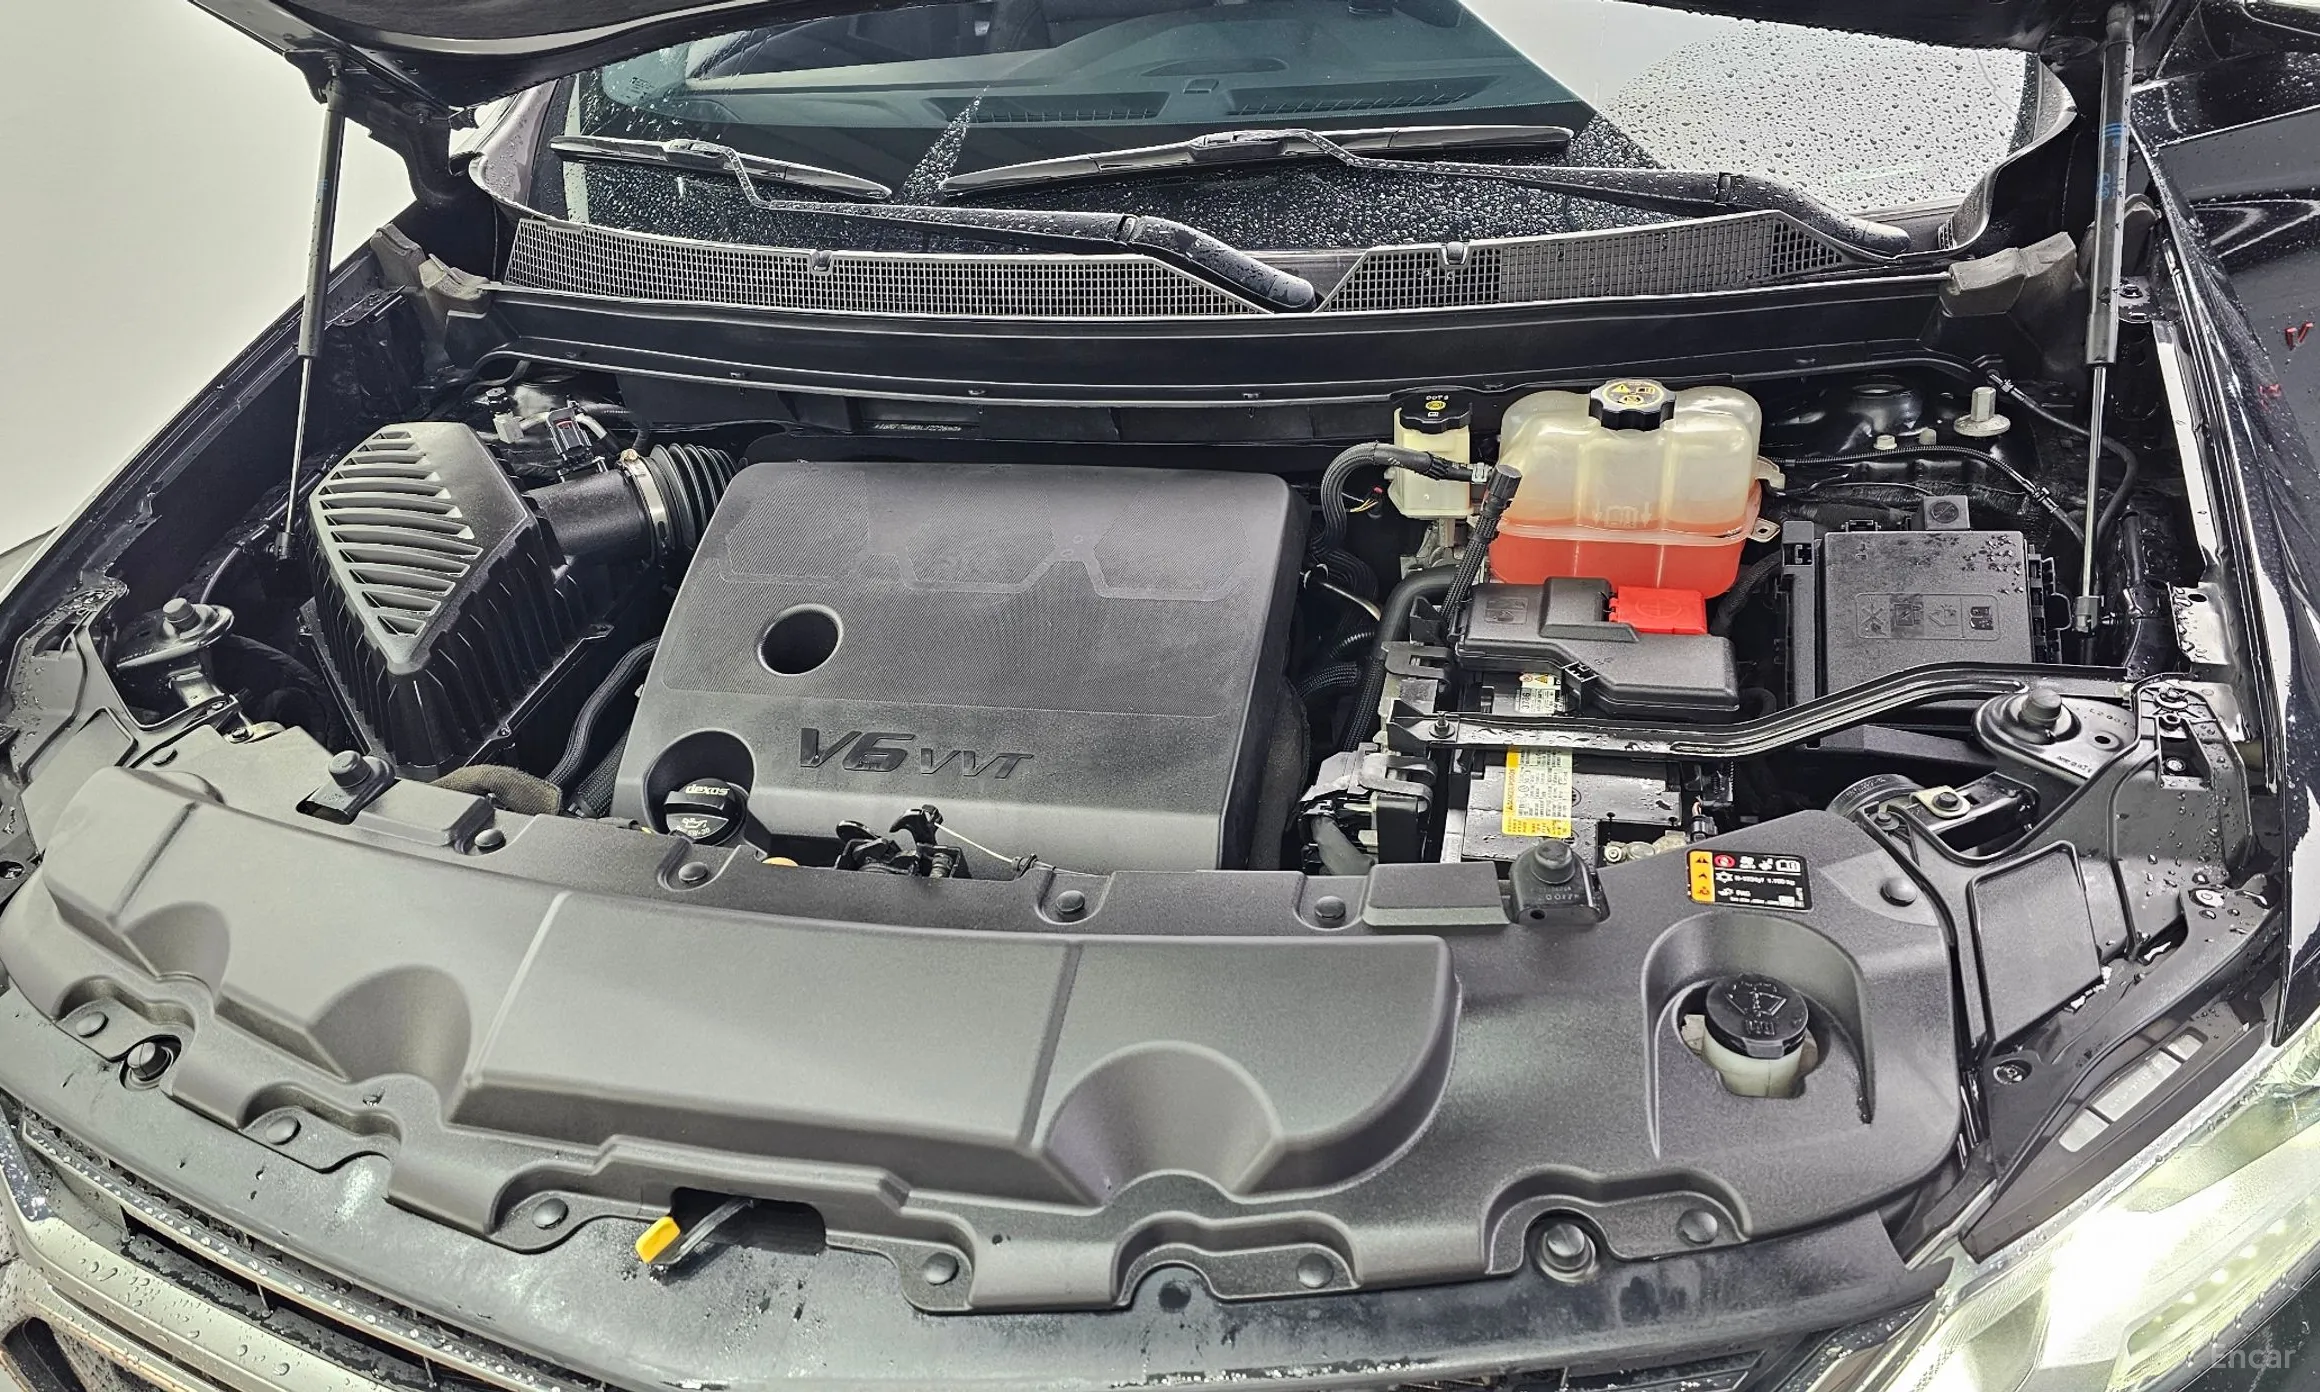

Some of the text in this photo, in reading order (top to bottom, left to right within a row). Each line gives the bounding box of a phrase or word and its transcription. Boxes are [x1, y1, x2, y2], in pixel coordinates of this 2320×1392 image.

[800, 727, 1034, 779] V6 VVT
[685, 784, 730, 796] dexos
